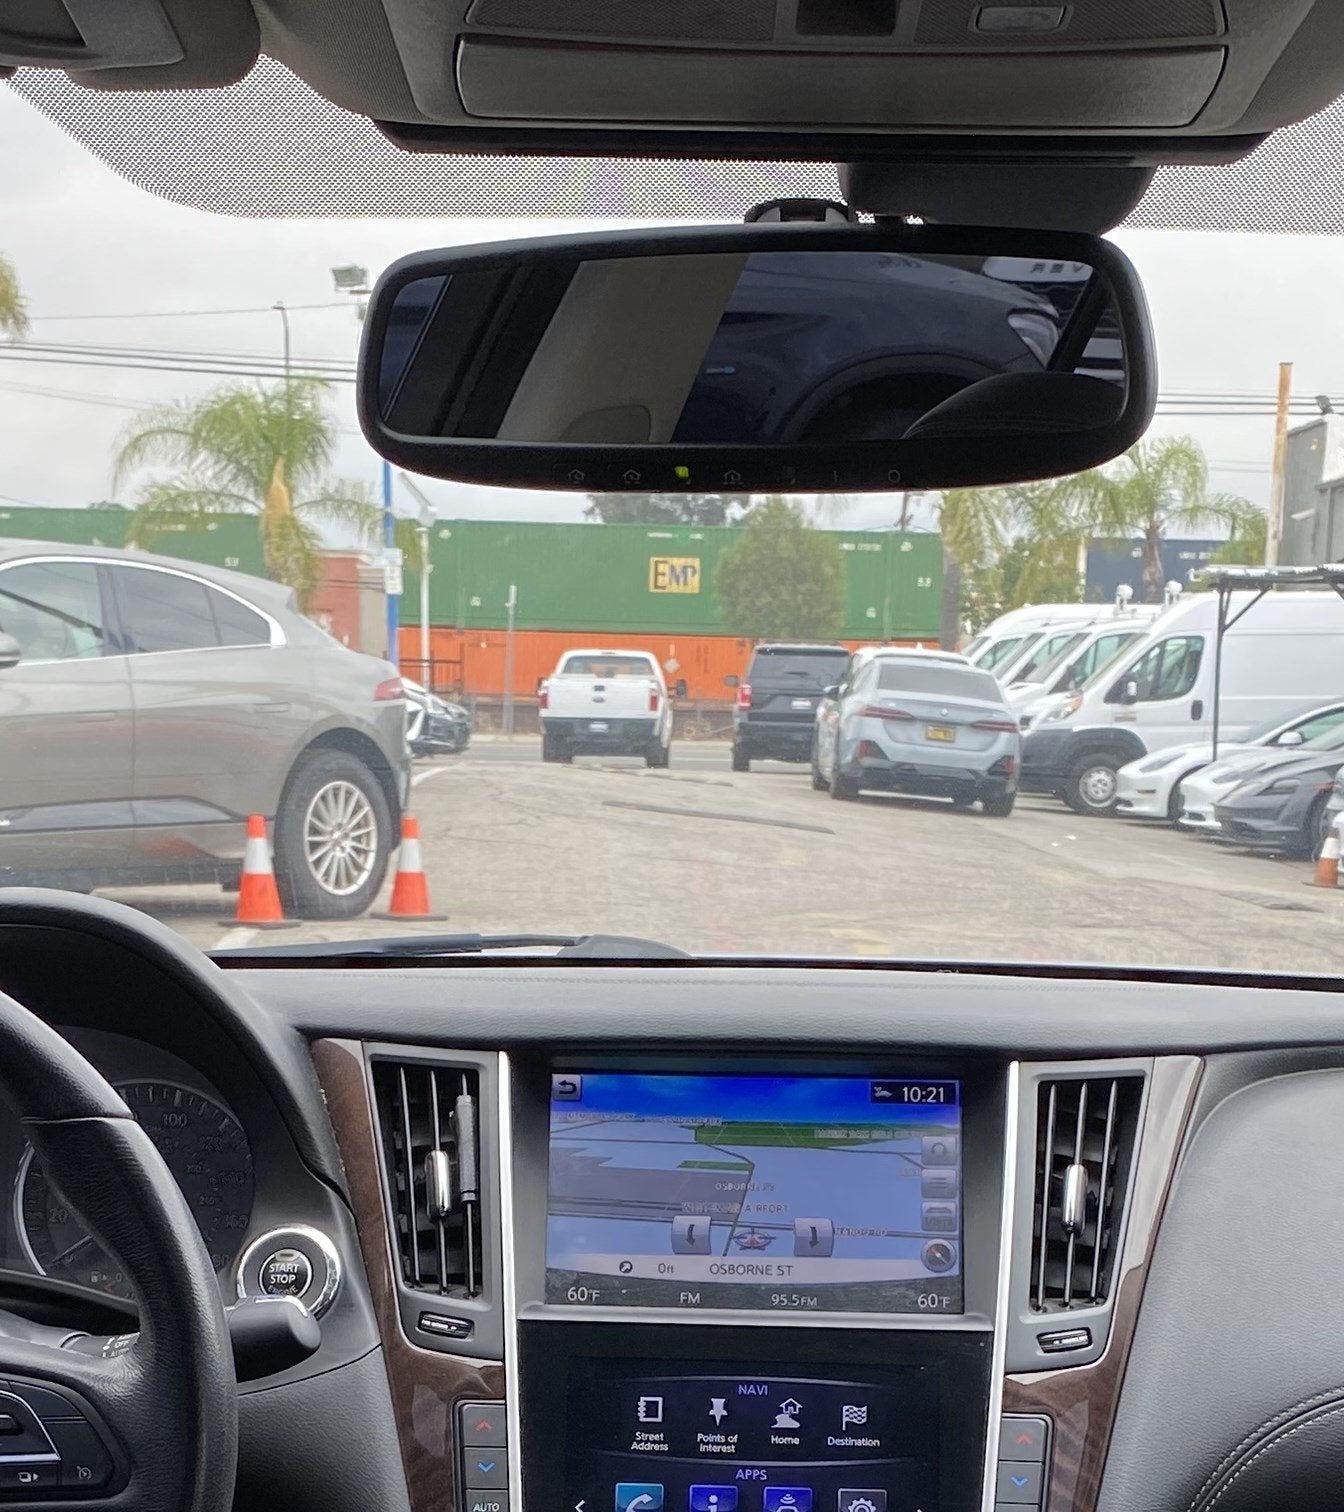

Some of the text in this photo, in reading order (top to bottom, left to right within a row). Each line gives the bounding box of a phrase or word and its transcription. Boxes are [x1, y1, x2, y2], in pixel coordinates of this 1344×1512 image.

[654, 559, 698, 591] EMP
[901, 1086, 945, 1104] 10:21
[744, 1203, 789, 1214] AIRPORT
[269, 1263, 300, 1273] START
[709, 1262, 762, 1277] OSBORNE
[765, 1264, 795, 1277] ST
[270, 1274, 296, 1284] STOP
[679, 1291, 701, 1305] FM
[737, 1383, 769, 1397] NAVI
[635, 1431, 665, 1442] Street
[697, 1433, 739, 1444] Points of
[770, 1435, 800, 1446] Home
[827, 1436, 881, 1448] Destination
[631, 1441, 669, 1452] Address
[699, 1443, 736, 1454] Interest
[735, 1468, 768, 1482] APPS
